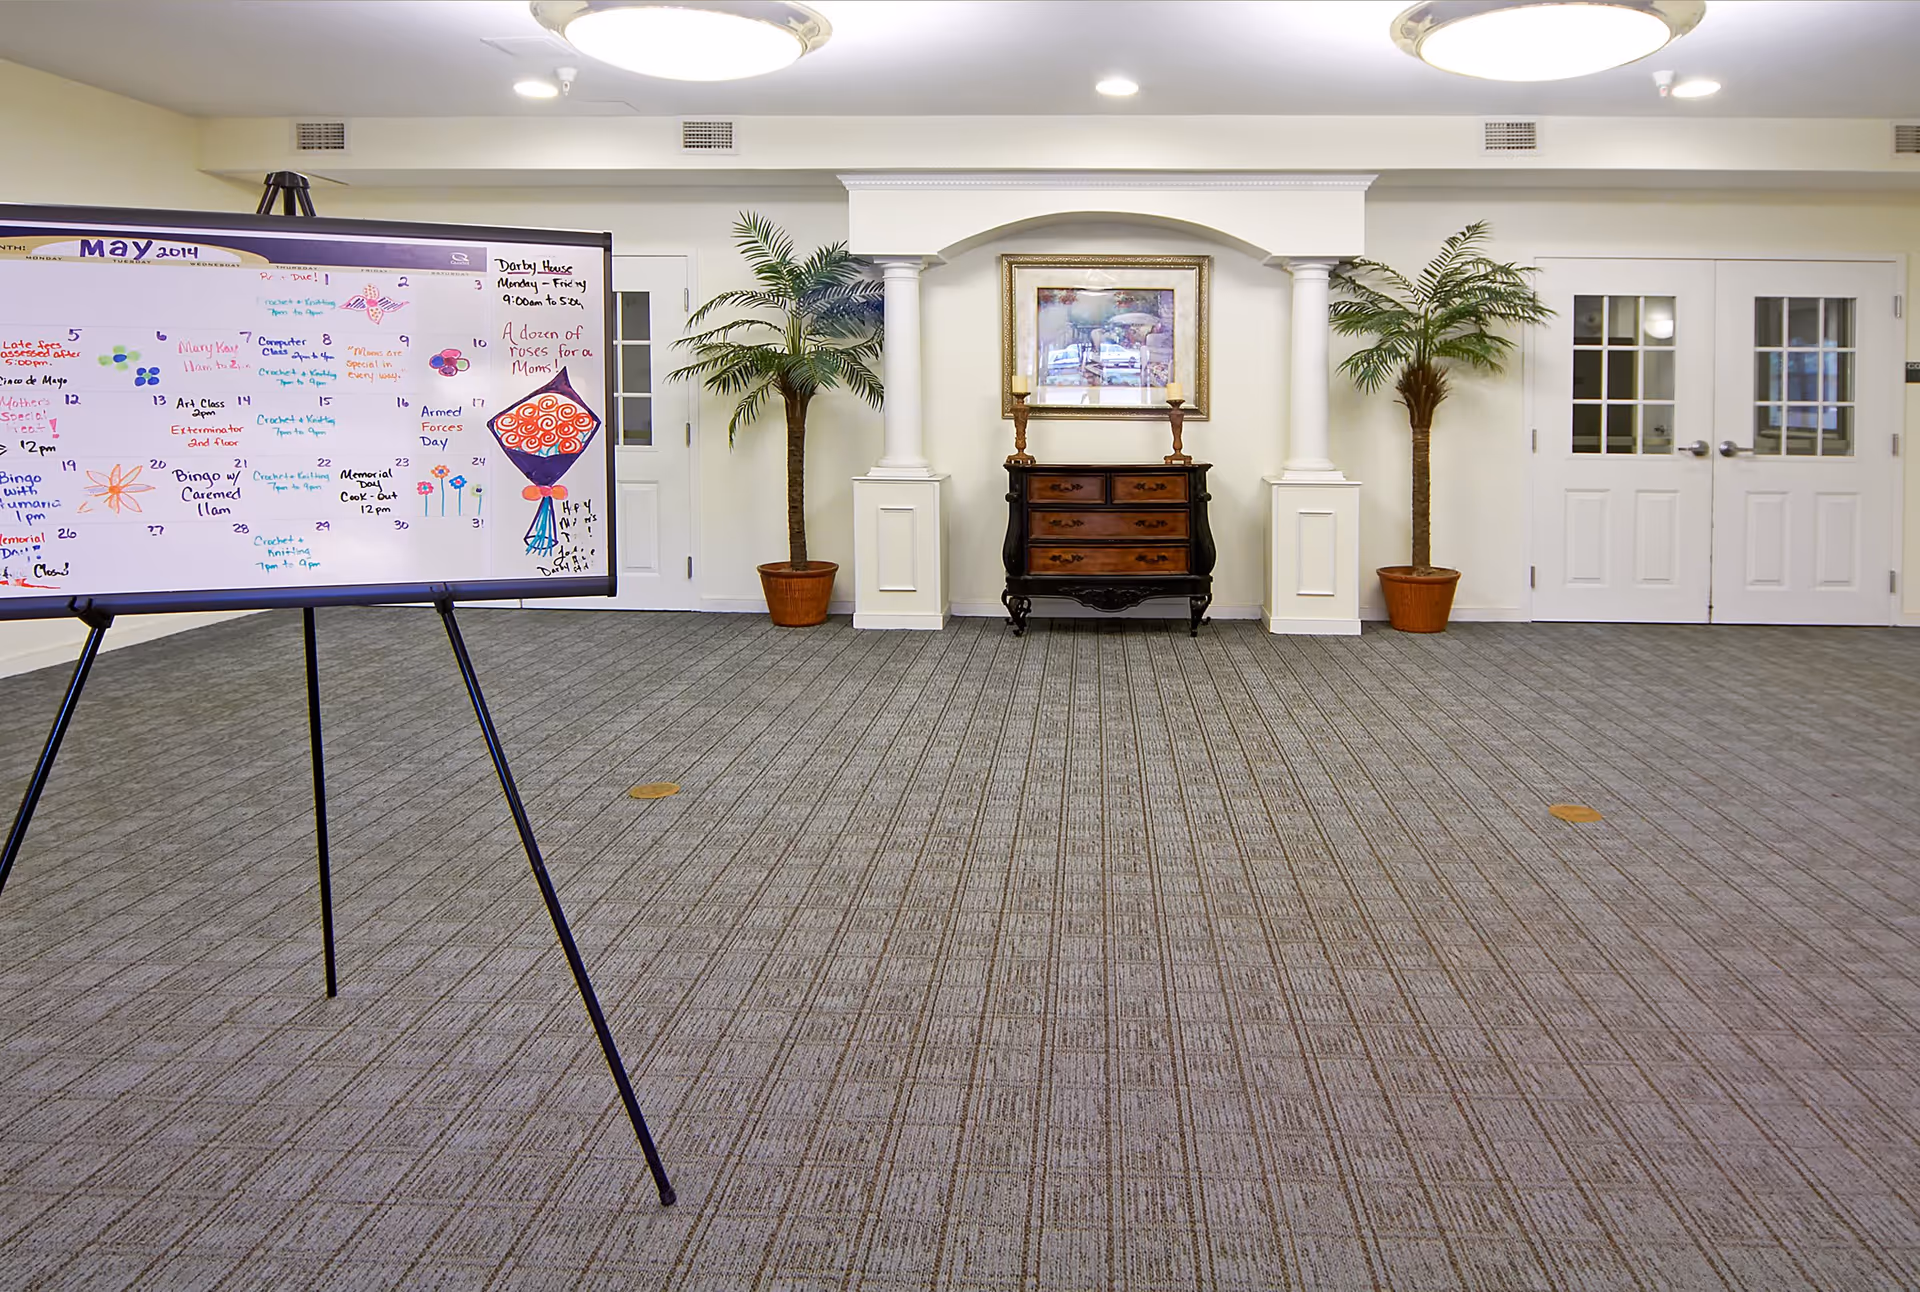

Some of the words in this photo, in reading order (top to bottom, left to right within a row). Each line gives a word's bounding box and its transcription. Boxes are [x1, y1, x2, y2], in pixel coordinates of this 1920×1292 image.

[80, 239, 153, 260] May
[156, 246, 198, 259] 2014
[494, 258, 537, 276] Darby
[542, 259, 573, 274] House
[398, 276, 409, 287] 2
[474, 279, 483, 290] 3
[497, 278, 538, 294] Monday
[257, 297, 293, 306] rochet
[503, 294, 543, 307] 9:00am
[546, 294, 557, 306] to
[293, 308, 303, 316] to
[68, 328, 82, 341] 5
[156, 331, 167, 341] 6
[239, 331, 252, 343] 7
[322, 333, 332, 345] 8
[503, 322, 518, 346] A
[520, 324, 558, 340] dozen
[566, 325, 584, 340] of
[3, 340, 32, 349] Late
[37, 340, 62, 349] fees
[258, 336, 307, 349] Computer
[399, 335, 409, 347] 9
[473, 338, 487, 348] 10
[0, 348, 50, 358] assessed
[53, 349, 81, 358] after
[178, 341, 213, 359] Mary
[262, 347, 288, 356] Class
[510, 346, 548, 358] roses
[559, 344, 580, 358] for
[383, 360, 392, 368] in
[512, 359, 559, 377] Moms!
[258, 368, 296, 376] Crochet
[26, 375, 37, 385] de
[42, 375, 68, 389] Mayo
[348, 372, 373, 384] every
[65, 394, 81, 405] 12
[153, 395, 166, 405] 13
[176, 397, 195, 409] Art
[200, 398, 225, 408] Class
[238, 395, 251, 406] 14
[320, 396, 333, 406] 15
[397, 397, 409, 407] 16
[192, 408, 215, 419] 2pm
[421, 406, 461, 418] Armed
[257, 413, 295, 425] Crochet
[171, 424, 244, 435] Exterminator
[421, 422, 463, 432] Forces
[188, 438, 209, 447] 2nd
[214, 437, 239, 446] floor
[420, 436, 448, 451] Day
[62, 459, 76, 471] 19
[150, 459, 166, 469] 20
[234, 458, 247, 468] 21
[317, 458, 331, 467] 22
[395, 458, 409, 467] 23
[472, 457, 486, 466] 24
[0, 471, 42, 487] Bingo
[172, 469, 220, 489] Bingo
[253, 470, 288, 481] Crochet
[340, 468, 393, 480] Memorial
[3, 485, 38, 497] with
[303, 482, 321, 492] 9pm
[356, 480, 383, 492] Day
[182, 486, 241, 502] Caremed
[198, 501, 230, 516] 11am
[232, 523, 249, 534] 28
[315, 521, 330, 531] 29
[394, 520, 409, 530] 30
[472, 519, 484, 528] 31
[58, 528, 77, 539] 26
[254, 535, 294, 546] Crochet
[255, 562, 278, 573] 7pm
[299, 558, 320, 571] 9pm
